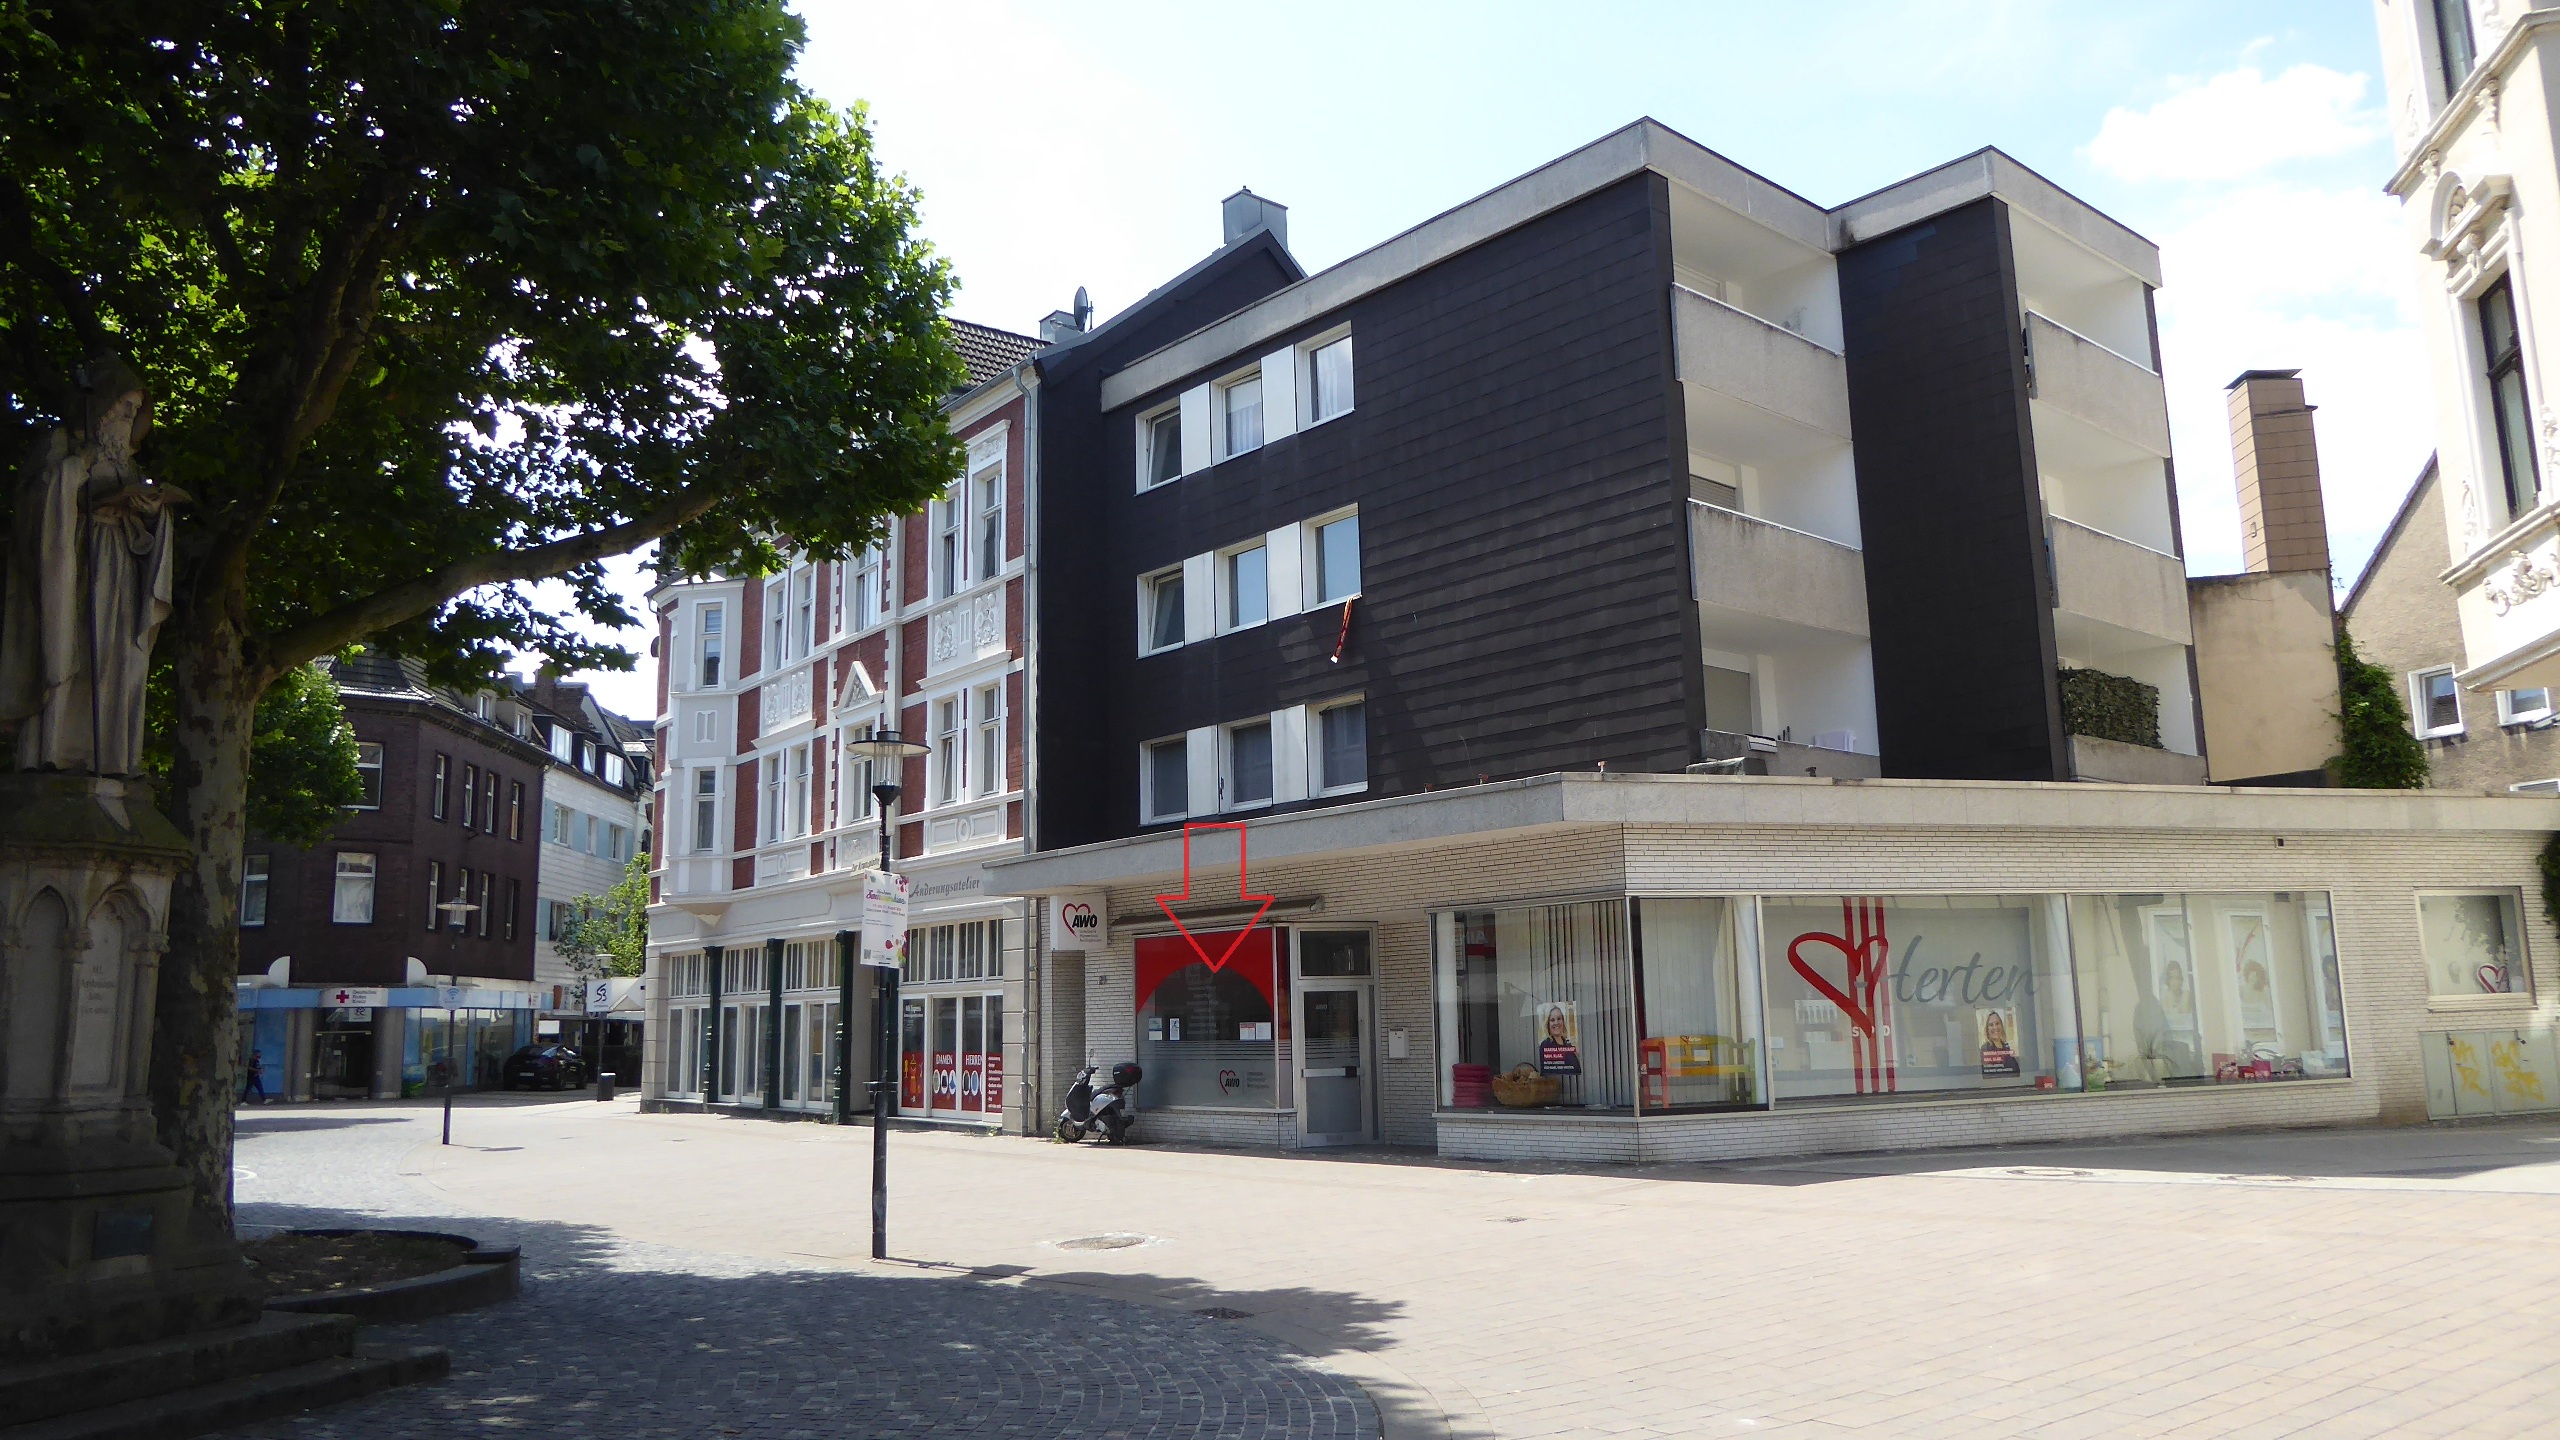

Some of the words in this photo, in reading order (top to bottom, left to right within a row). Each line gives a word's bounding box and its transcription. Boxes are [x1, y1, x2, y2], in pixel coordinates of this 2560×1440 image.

[1071, 914, 1098, 928] AWO
[935, 1053, 953, 1065] DAMEN
[1224, 1078, 1240, 1088] AWO
